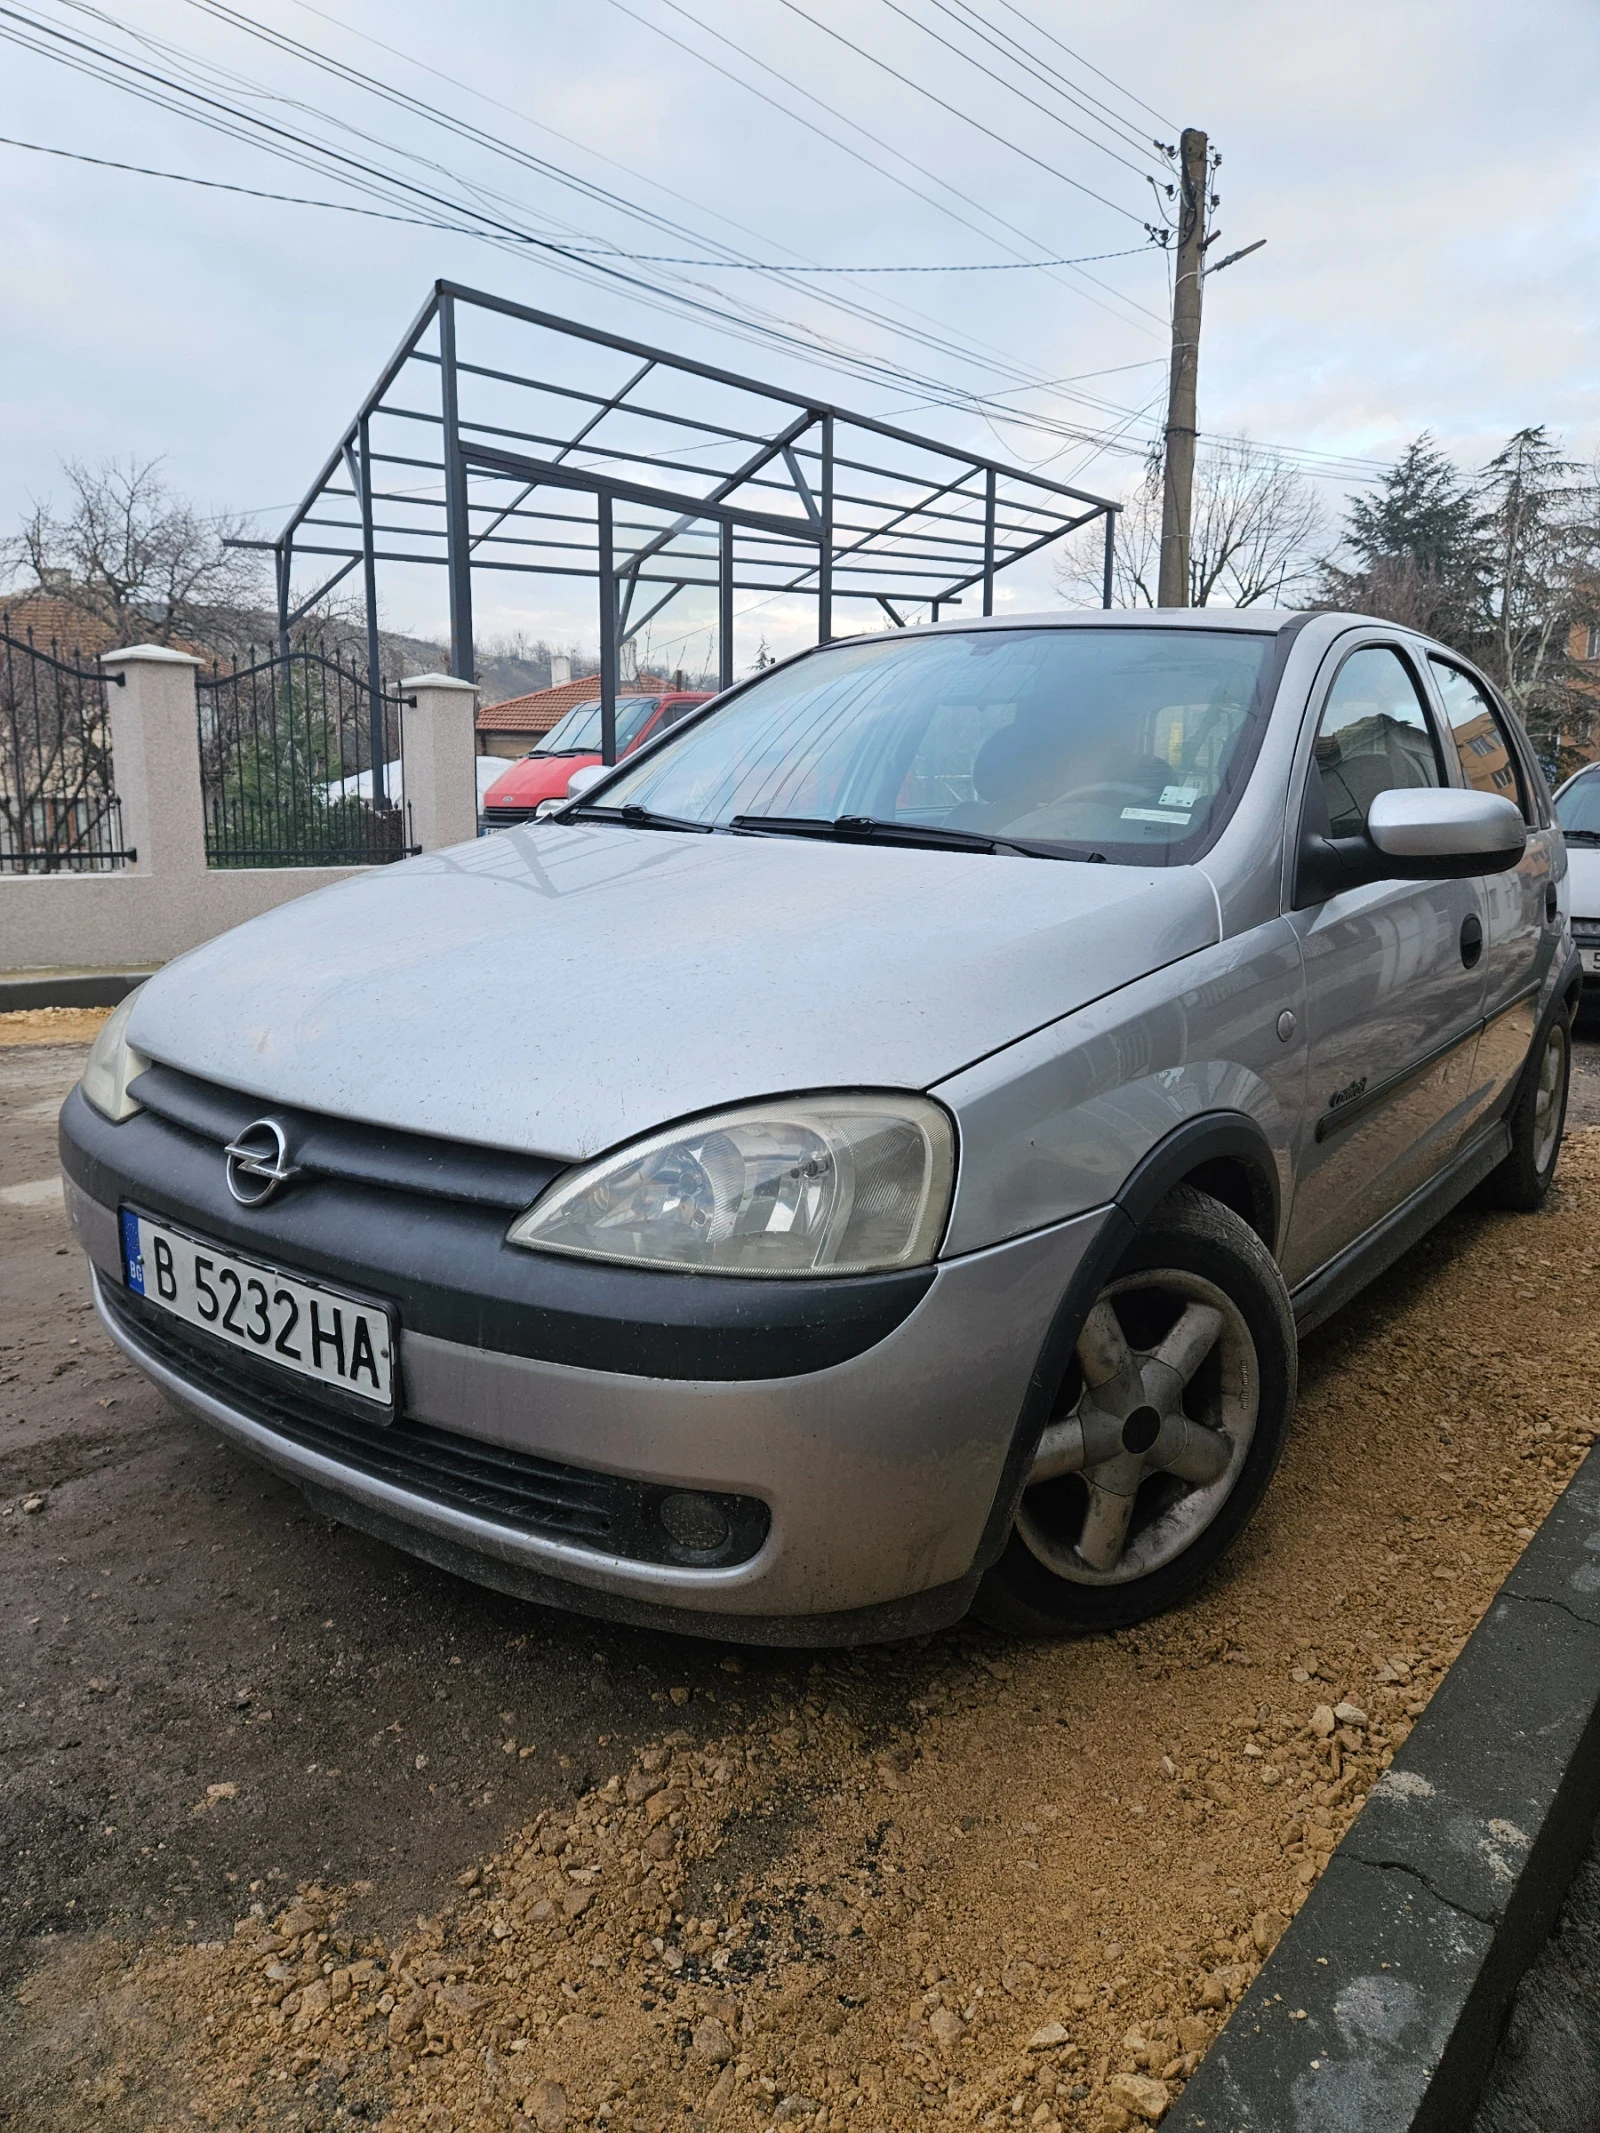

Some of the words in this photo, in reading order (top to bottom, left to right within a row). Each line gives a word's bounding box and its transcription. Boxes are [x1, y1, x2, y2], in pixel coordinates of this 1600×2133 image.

[129, 1260, 143, 1283] BG
[153, 1236, 177, 1302] B
[195, 1255, 302, 1361] 5232
[310, 1300, 381, 1389] HA
